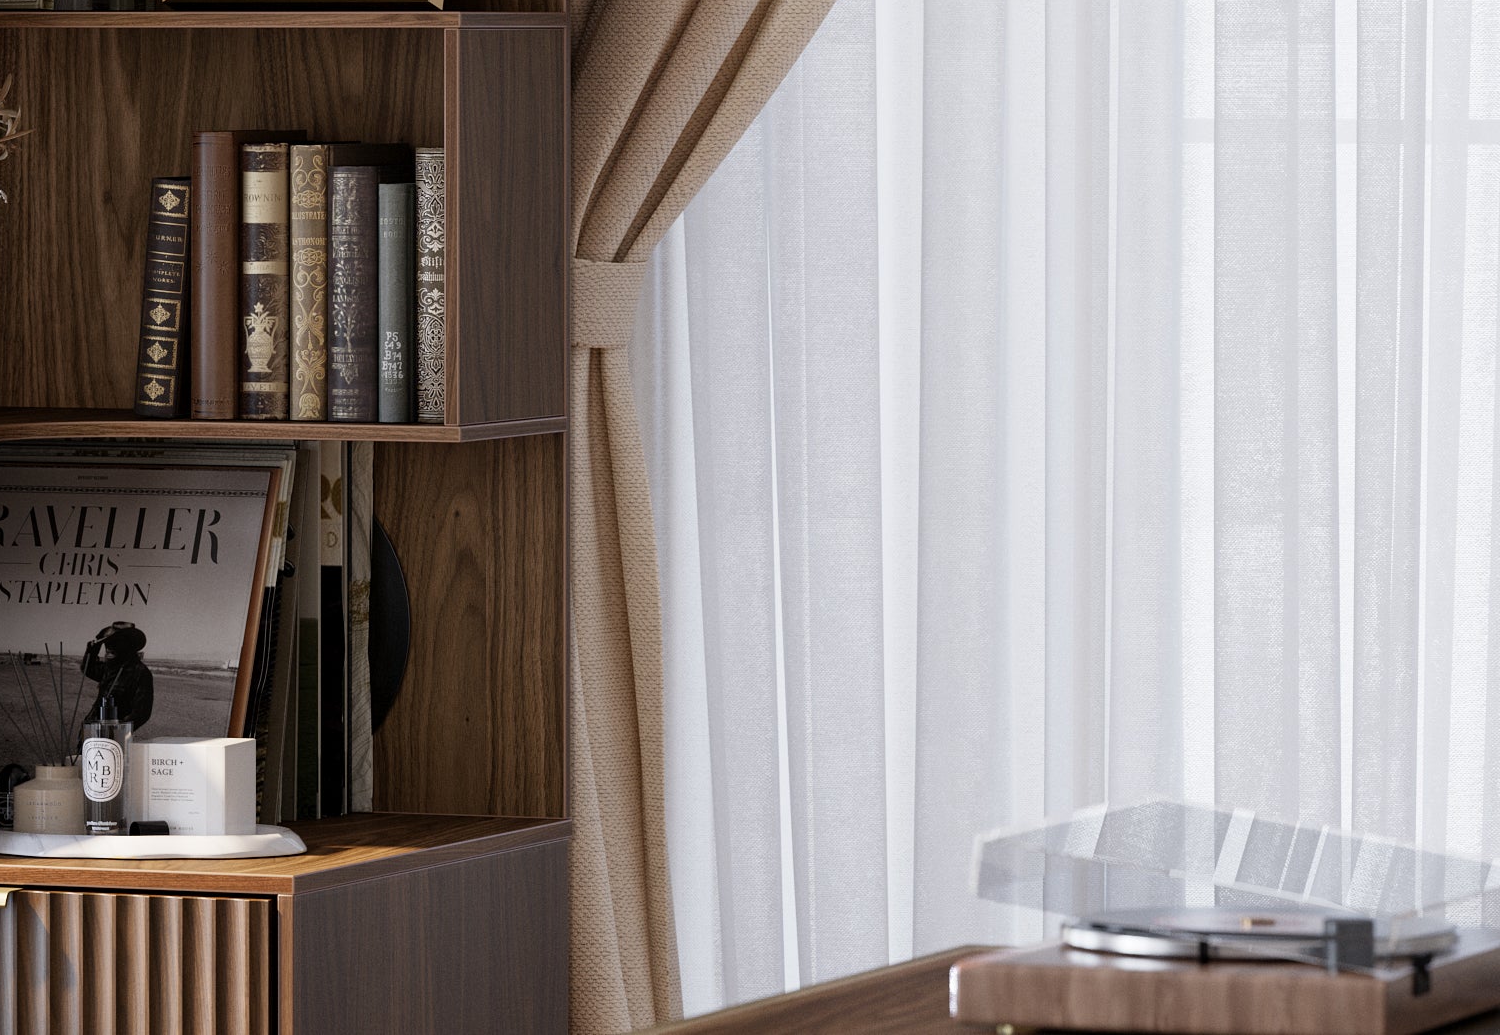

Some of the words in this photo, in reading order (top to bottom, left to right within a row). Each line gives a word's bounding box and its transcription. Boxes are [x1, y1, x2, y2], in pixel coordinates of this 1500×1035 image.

[243, 194, 282, 203] ROWNIN
[386, 331, 399, 342] PS
[38, 551, 121, 577] CHRIS
[151, 758, 177, 766] BIRCH
[151, 768, 174, 776] SAGE
